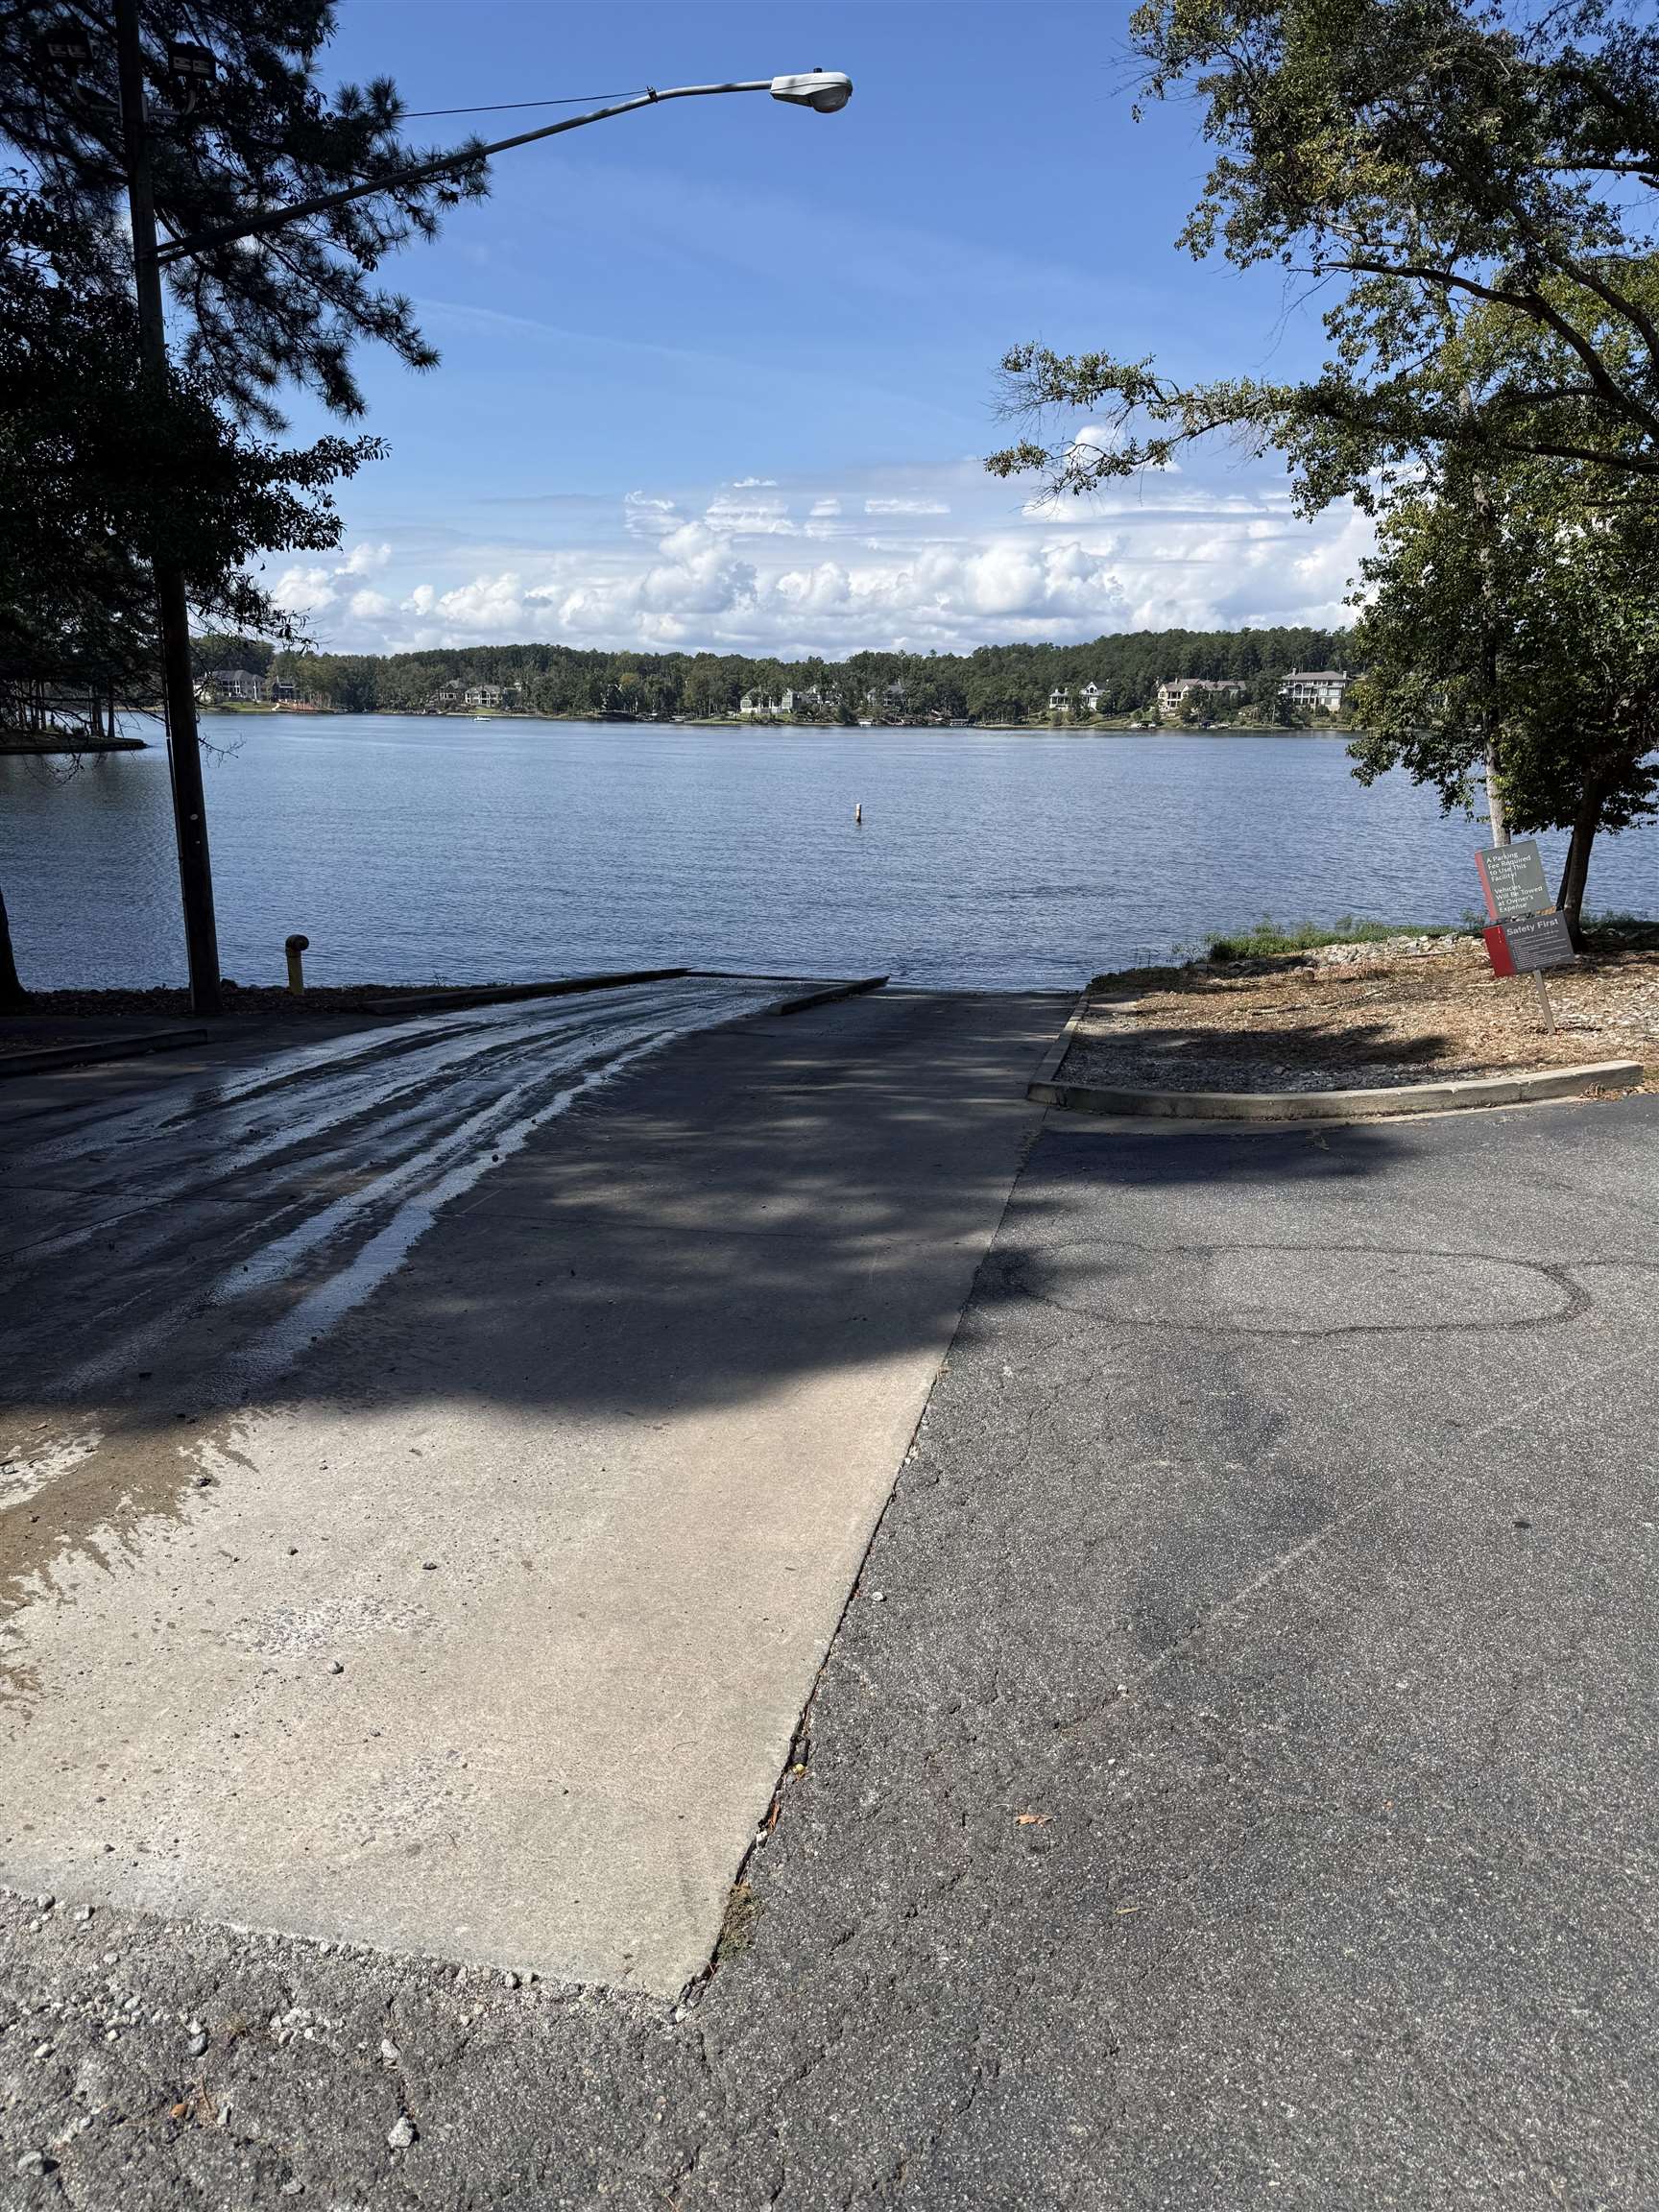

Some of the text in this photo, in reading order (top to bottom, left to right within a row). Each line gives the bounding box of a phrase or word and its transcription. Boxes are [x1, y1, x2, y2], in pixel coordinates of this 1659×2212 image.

[1493, 852, 1519, 862] Parking
[1521, 885, 1543, 895] Towed
[1506, 925, 1535, 936] Safety
[1536, 918, 1559, 929] First
